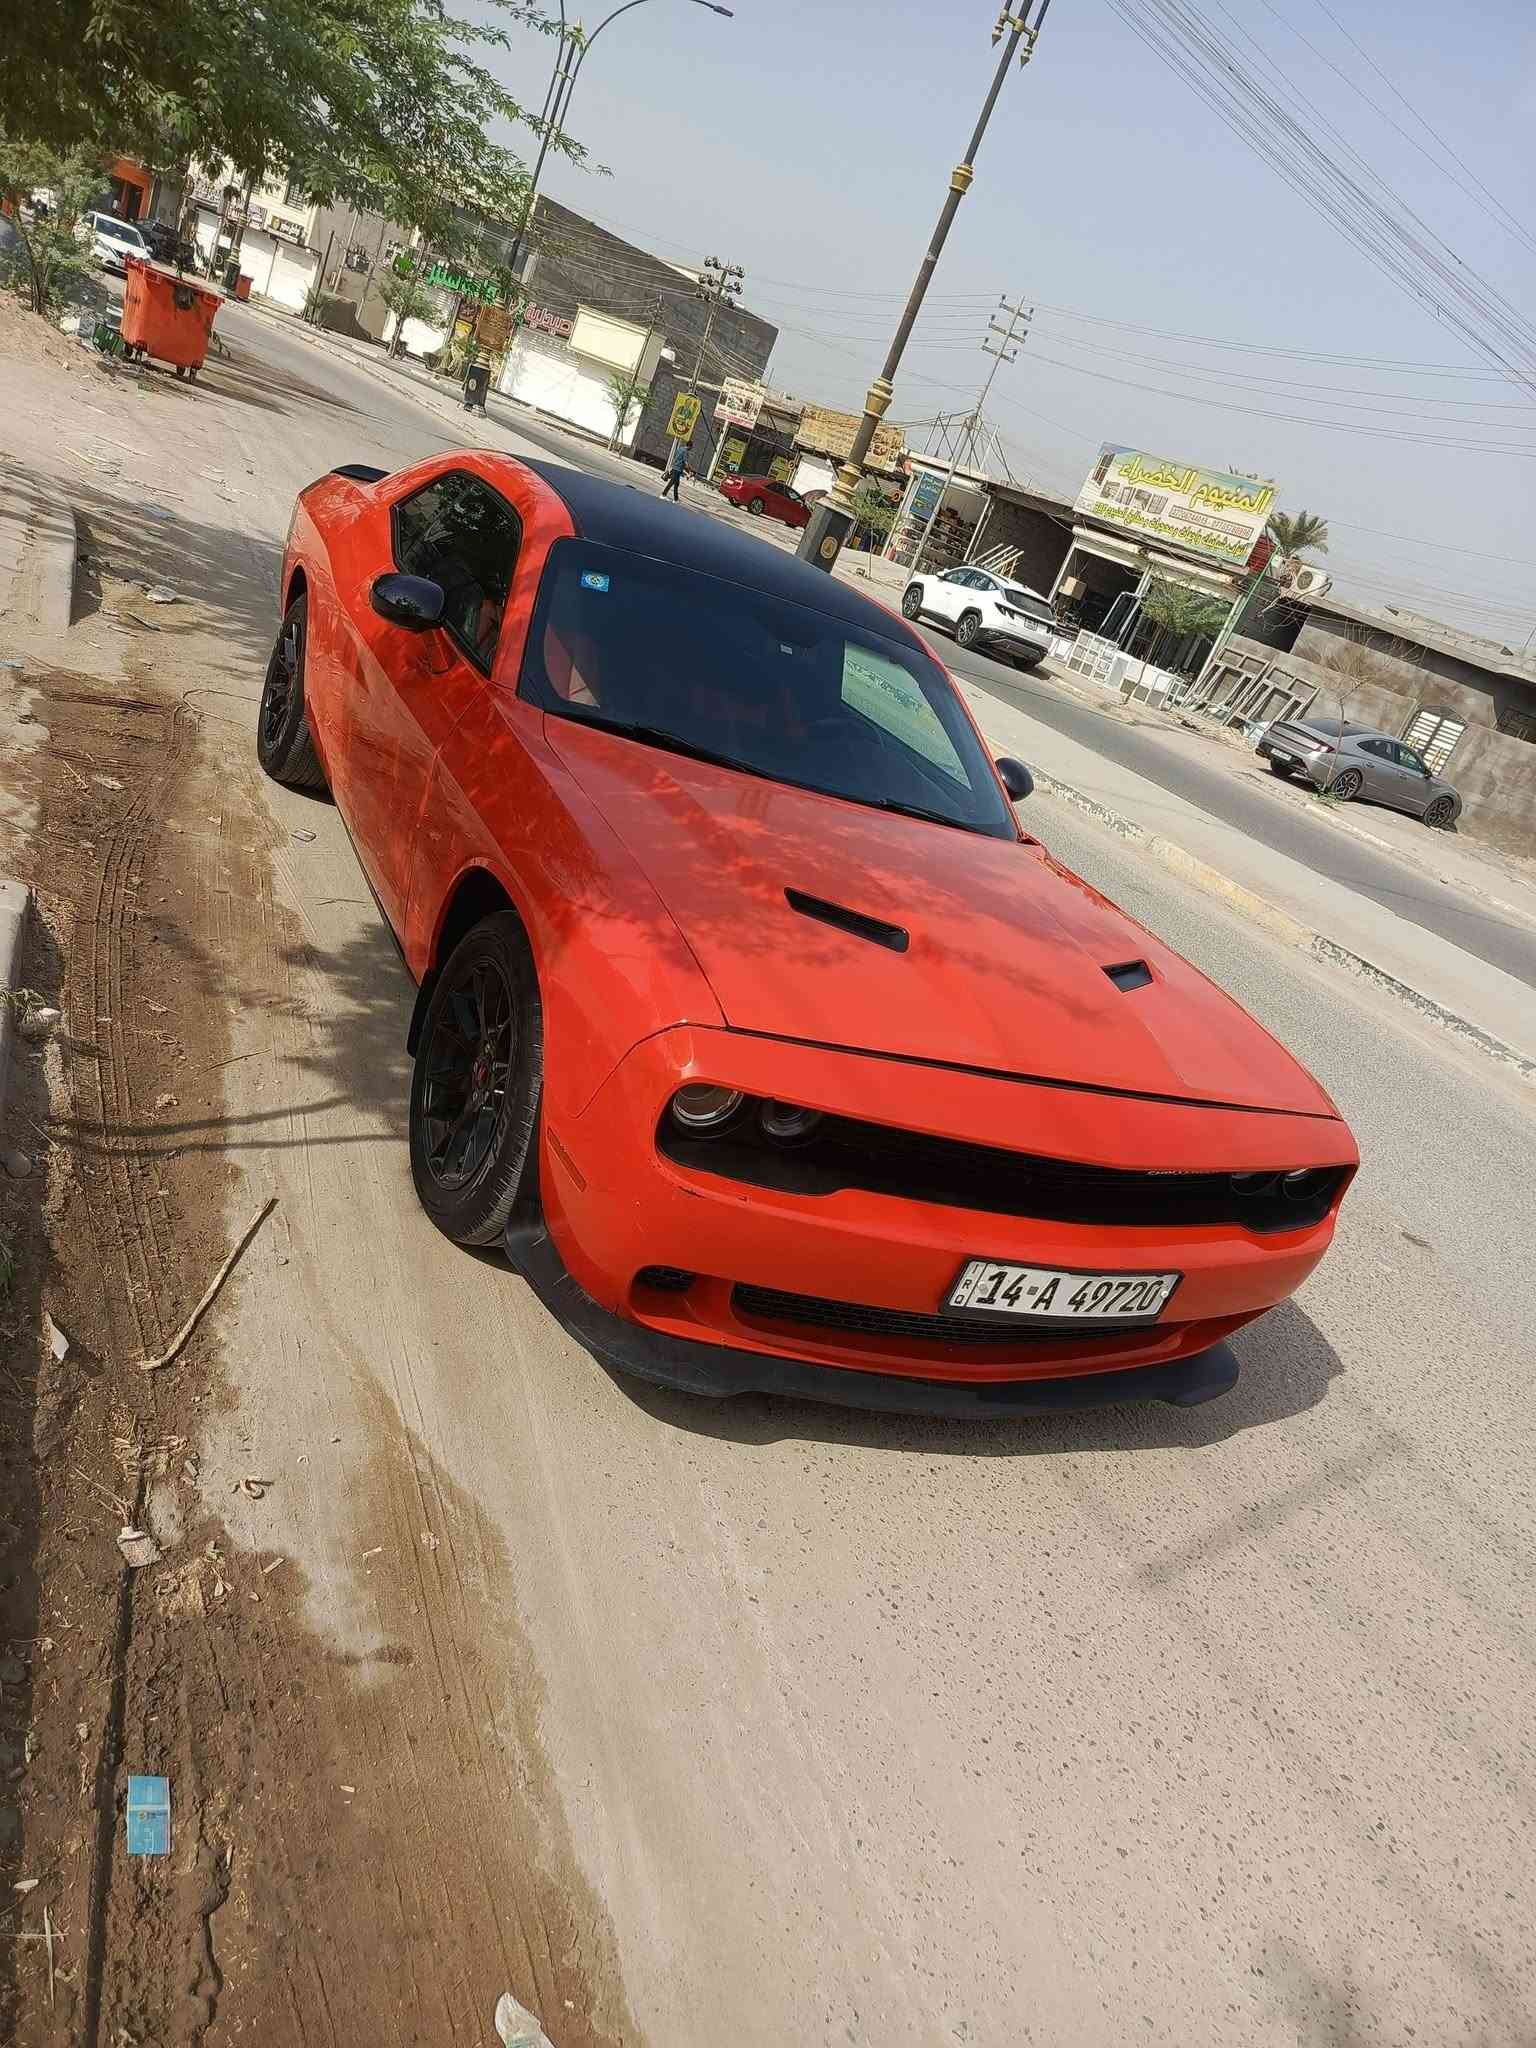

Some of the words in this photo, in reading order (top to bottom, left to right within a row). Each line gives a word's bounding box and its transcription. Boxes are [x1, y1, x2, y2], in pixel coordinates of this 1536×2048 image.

[524, 301, 573, 337] صيدلية
[1119, 455, 1197, 494] الخضراء
[1189, 485, 1273, 514] المنيوم
[954, 1262, 978, 1305] IRQ
[1067, 1280, 1163, 1313] 49720
